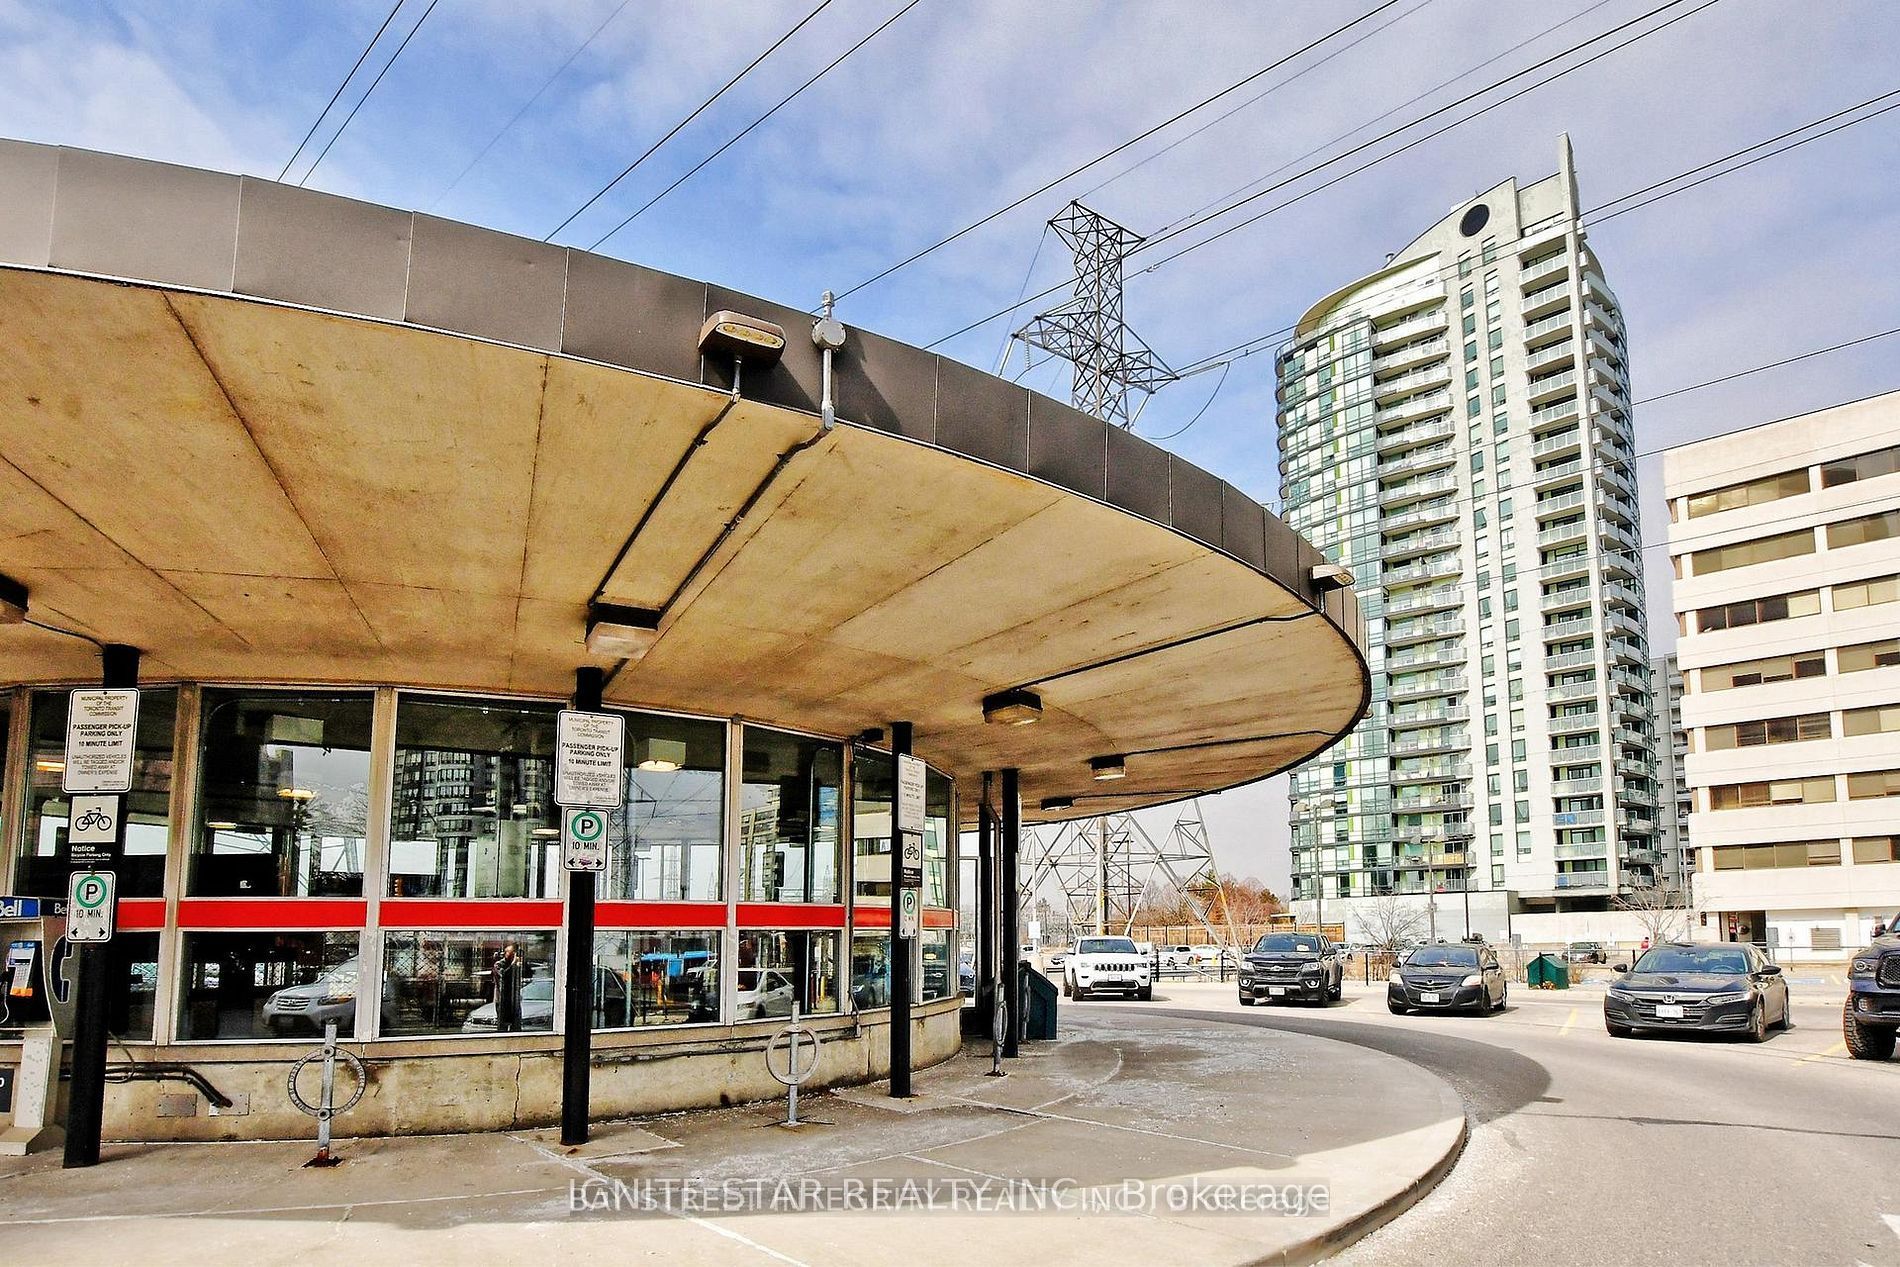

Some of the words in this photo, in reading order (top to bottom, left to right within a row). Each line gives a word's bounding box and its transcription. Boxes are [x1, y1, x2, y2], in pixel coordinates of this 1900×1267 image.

[562, 742, 596, 750] PASSENGER
[596, 744, 619, 752] PICK-UP
[581, 819, 593, 834] P
[572, 841, 580, 850] 10
[86, 884, 98, 900] P
[906, 896, 913, 910] P
[75, 909, 84, 918] 10
